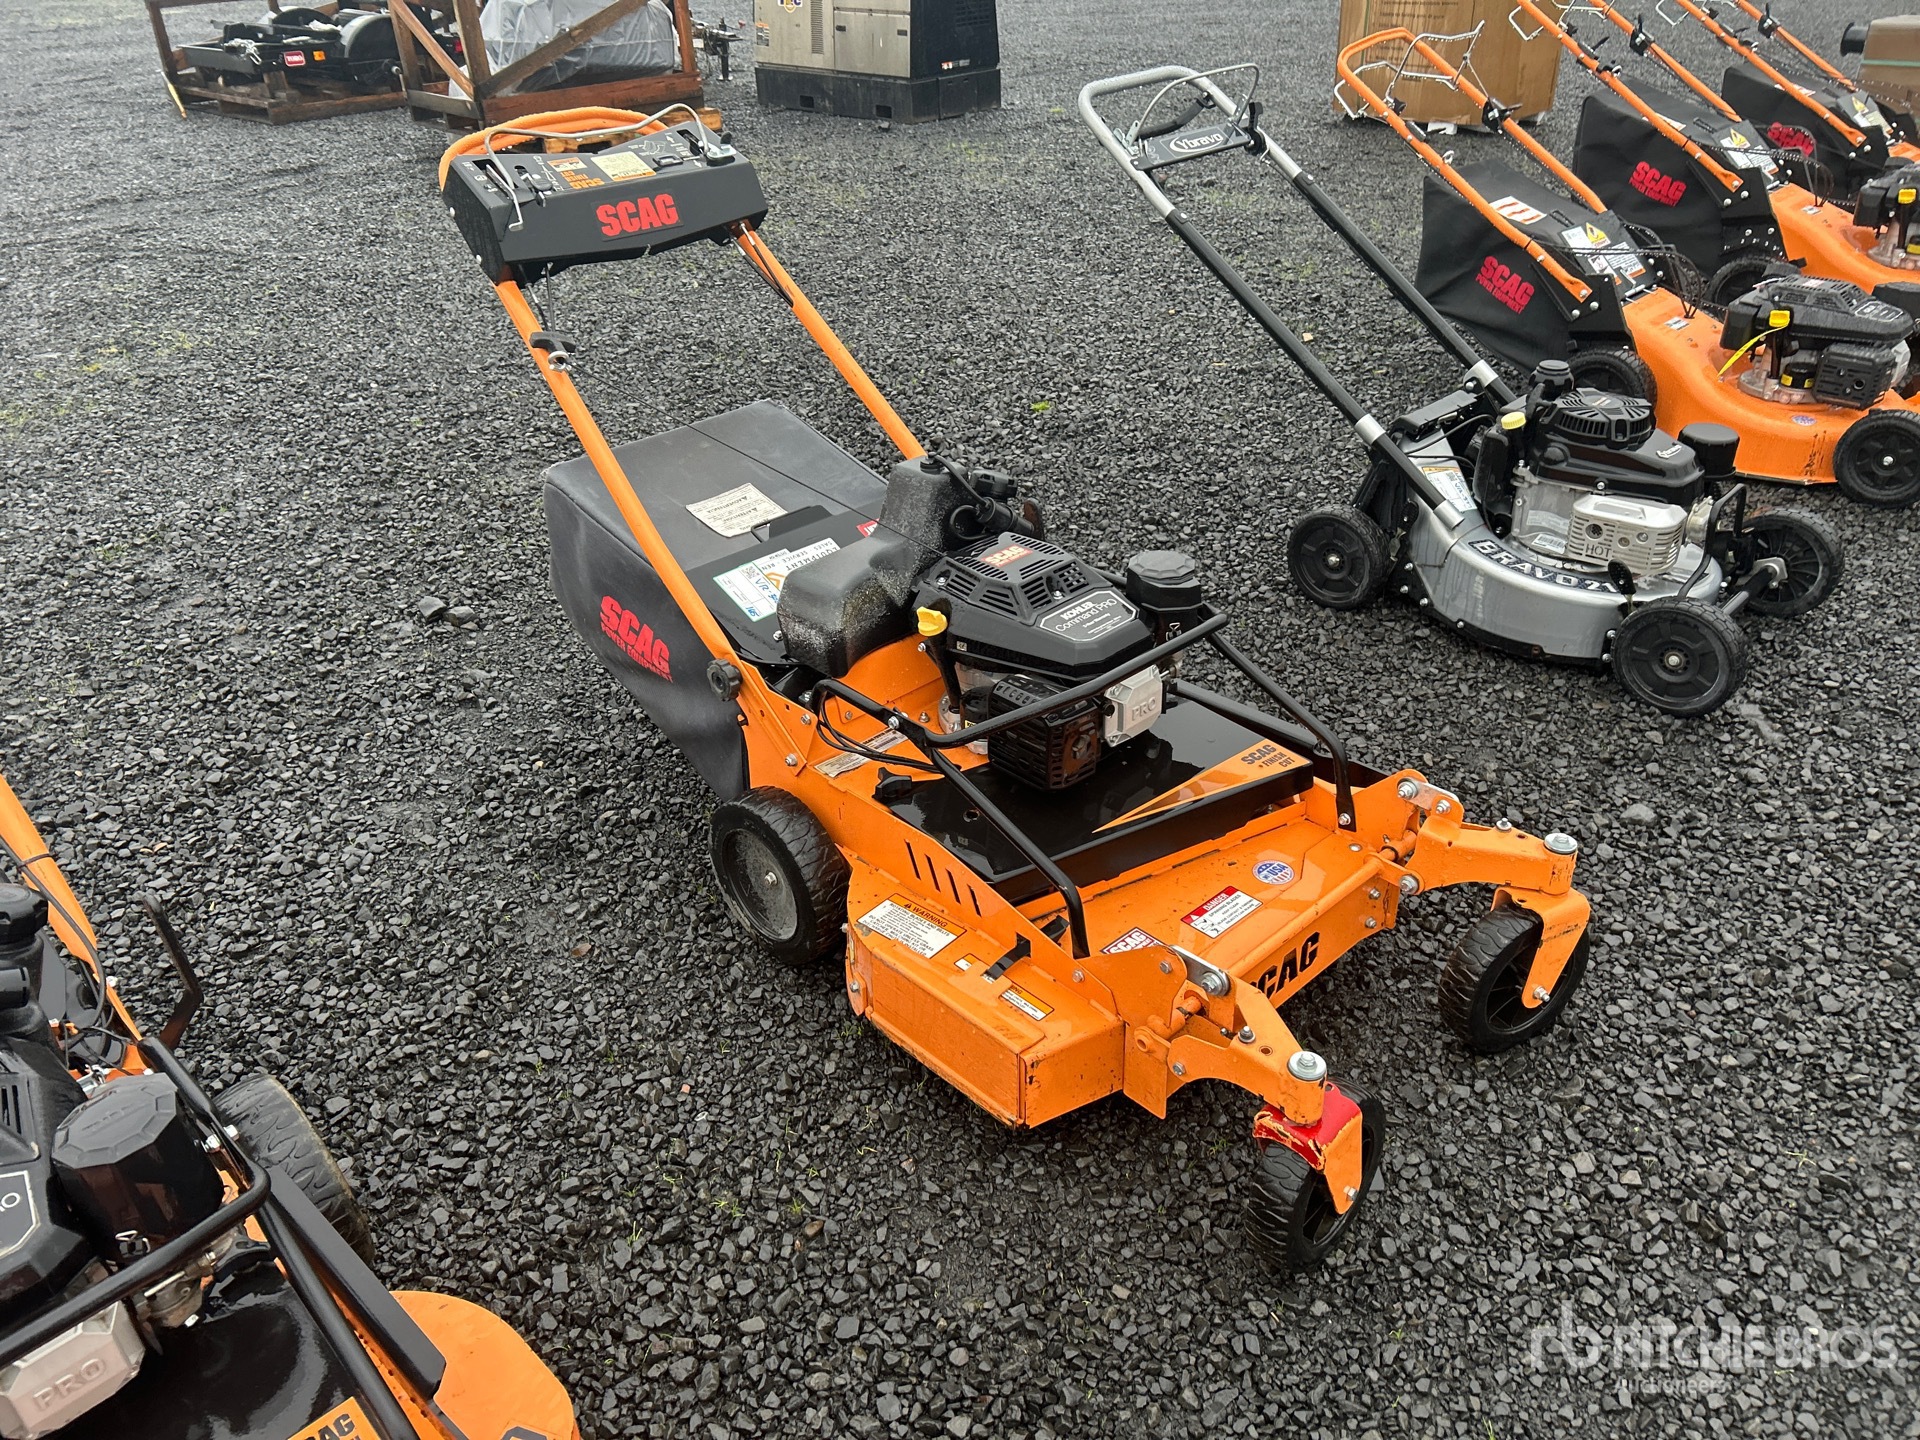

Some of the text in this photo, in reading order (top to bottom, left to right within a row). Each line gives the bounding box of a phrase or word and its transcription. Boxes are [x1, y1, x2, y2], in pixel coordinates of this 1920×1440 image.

[569, 178, 605, 190] SCAG
[1633, 161, 1686, 201] SCAG
[596, 193, 679, 236] SCAG
[1480, 256, 1535, 305] SCAG
[813, 541, 833, 551] SALES
[985, 545, 1024, 564] SCAG
[1585, 544, 1612, 558] HOT
[1474, 540, 1579, 587] BRAVO
[1056, 607, 1098, 631] Command
[1099, 599, 1117, 611] PRO
[1060, 602, 1096, 620] KOHLER
[600, 595, 670, 674] SCAG
[600, 621, 626, 652] POWER
[1132, 697, 1156, 721] PRO
[1241, 744, 1277, 765] SCAG
[1262, 751, 1287, 767] FINISH
[1278, 757, 1295, 767] CUT
[1267, 863, 1288, 876] USA
[1203, 893, 1229, 911] DANGER
[912, 906, 949, 928] WARNING
[1248, 931, 1320, 1000] CAG
[33, 1358, 105, 1412] PRO
